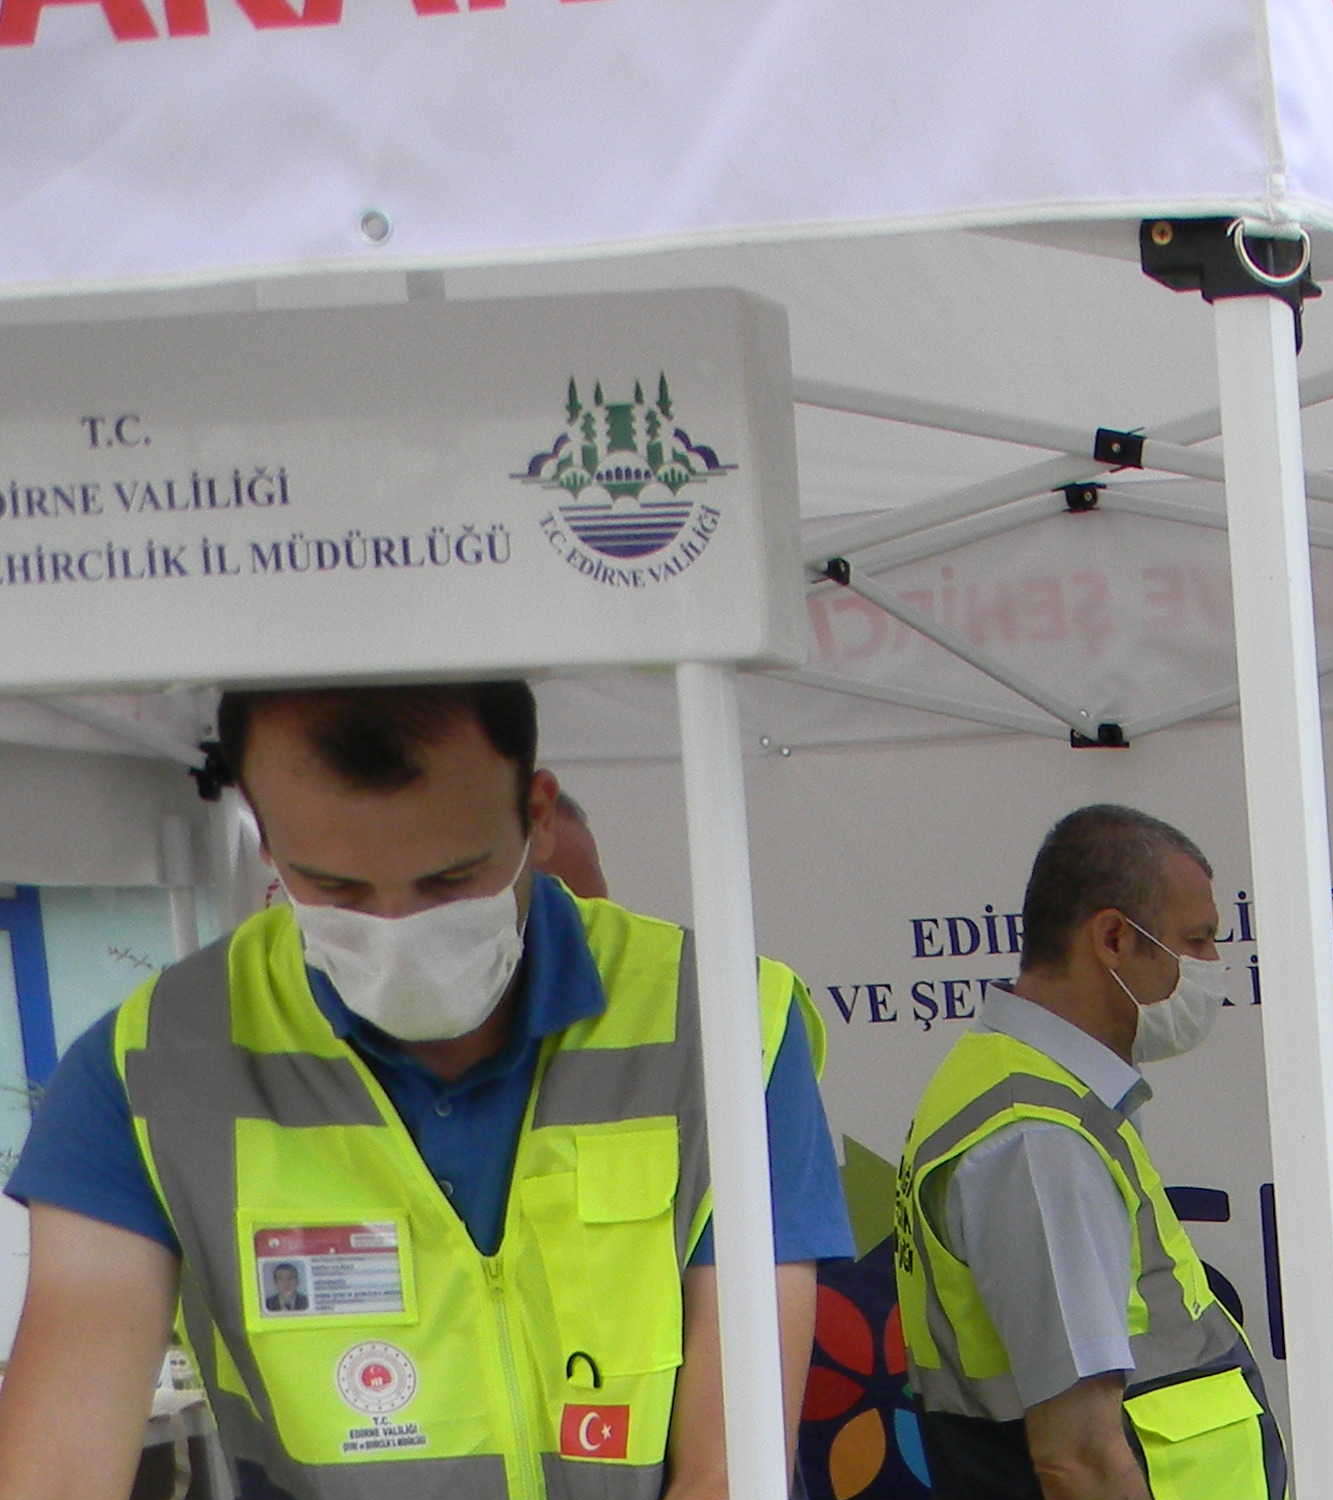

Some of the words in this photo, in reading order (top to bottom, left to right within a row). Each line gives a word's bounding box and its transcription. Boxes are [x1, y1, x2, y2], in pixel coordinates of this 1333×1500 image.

[81, 415, 152, 449] T.C.
[114, 465, 292, 514] VALİLİĞİ
[0, 538, 190, 585] HİRCİLİK
[201, 536, 241, 577] İL
[251, 523, 512, 574] MÜDÜRLÜĞÜ
[566, 547, 647, 589] EDİRNE
[648, 504, 722, 584] VALİLİĞİ
[828, 983, 899, 1025] VE
